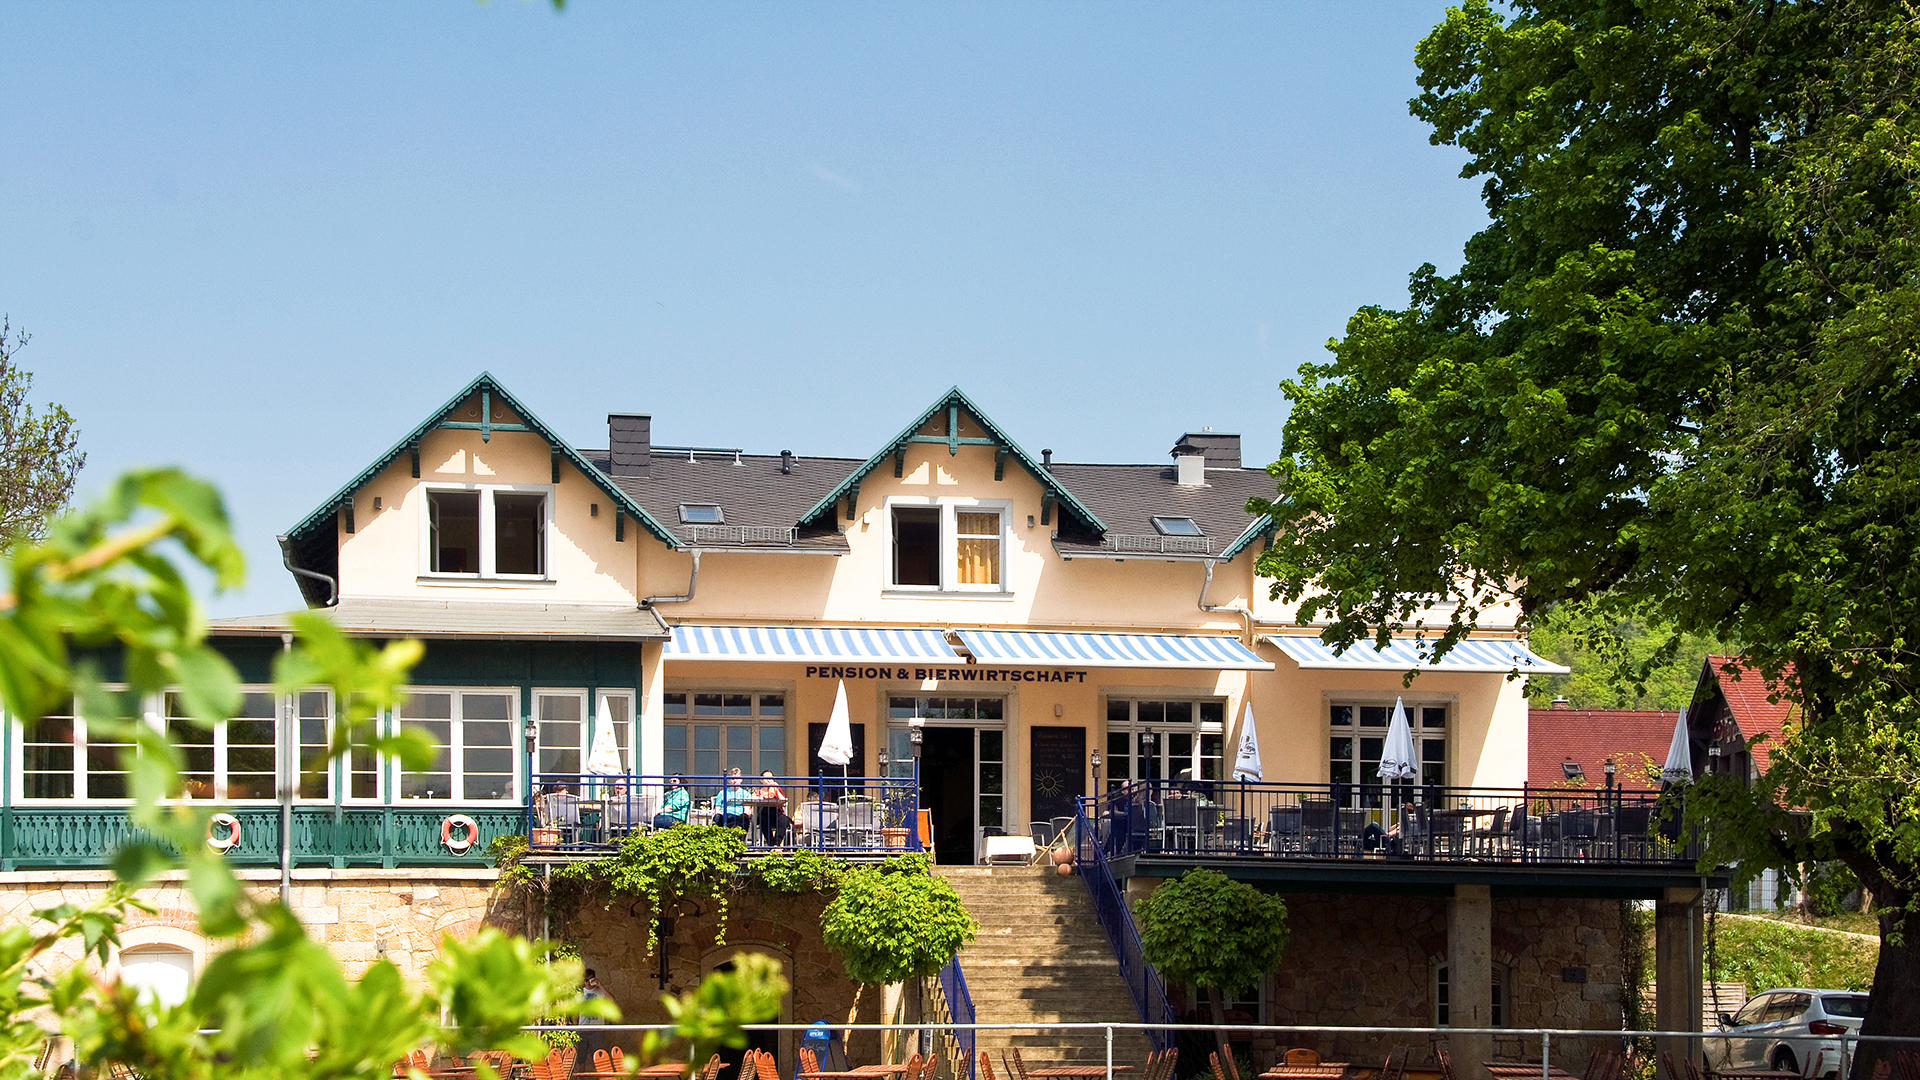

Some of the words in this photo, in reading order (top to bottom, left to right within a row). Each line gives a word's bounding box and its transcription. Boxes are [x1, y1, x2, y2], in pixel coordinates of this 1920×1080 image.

[806, 666, 891, 679] PENSION
[897, 667, 909, 680] &
[915, 668, 1088, 683] BIERWIRTSCHAFT
